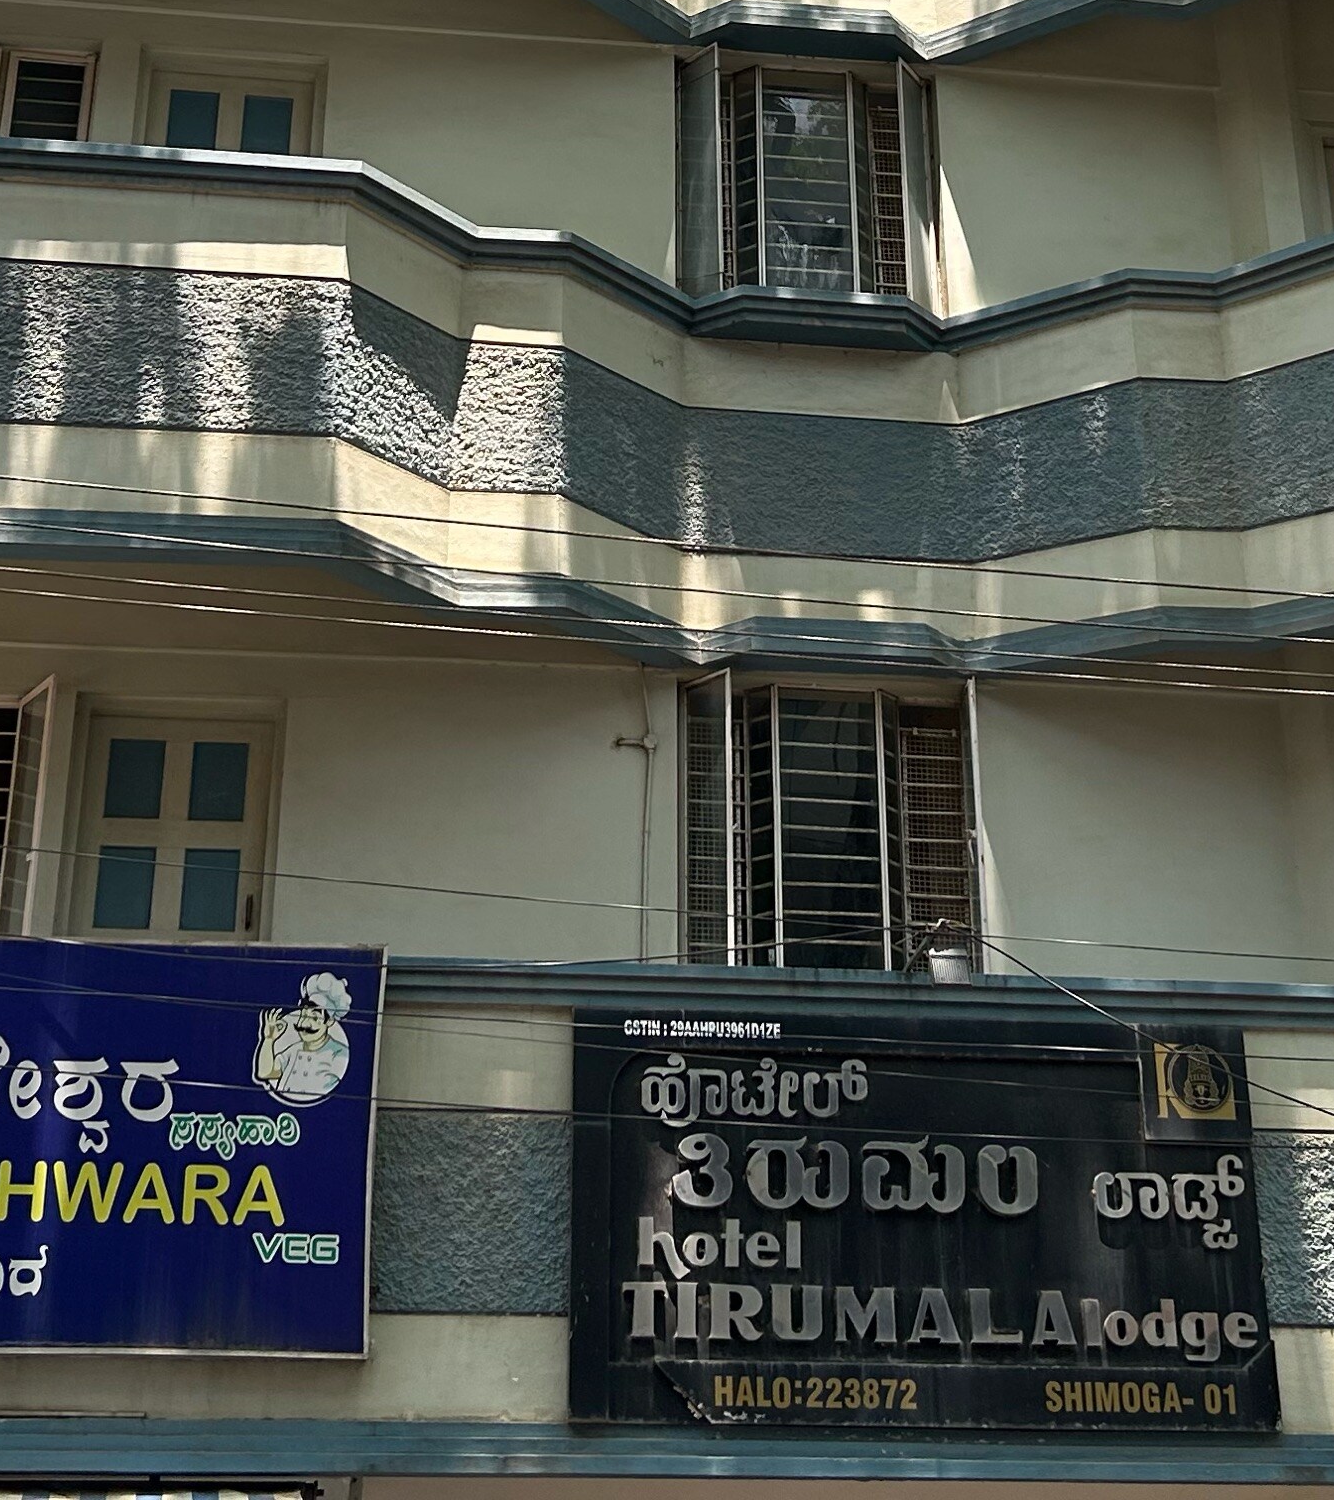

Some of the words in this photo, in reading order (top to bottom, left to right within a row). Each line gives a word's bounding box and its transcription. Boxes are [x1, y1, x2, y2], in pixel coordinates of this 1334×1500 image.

[623, 1019, 661, 1036] GSTIN
[671, 1132, 1039, 1216] ತಿರುಮಲ
[1092, 1154, 1246, 1249] ಲಾಡ್ಜ್
[252, 1232, 340, 1265] VEG
[637, 1215, 803, 1280] hotel
[622, 1280, 1078, 1346] TIRUMALA
[1080, 1297, 1259, 1362] lodge
[1204, 1382, 1238, 1415] 01
